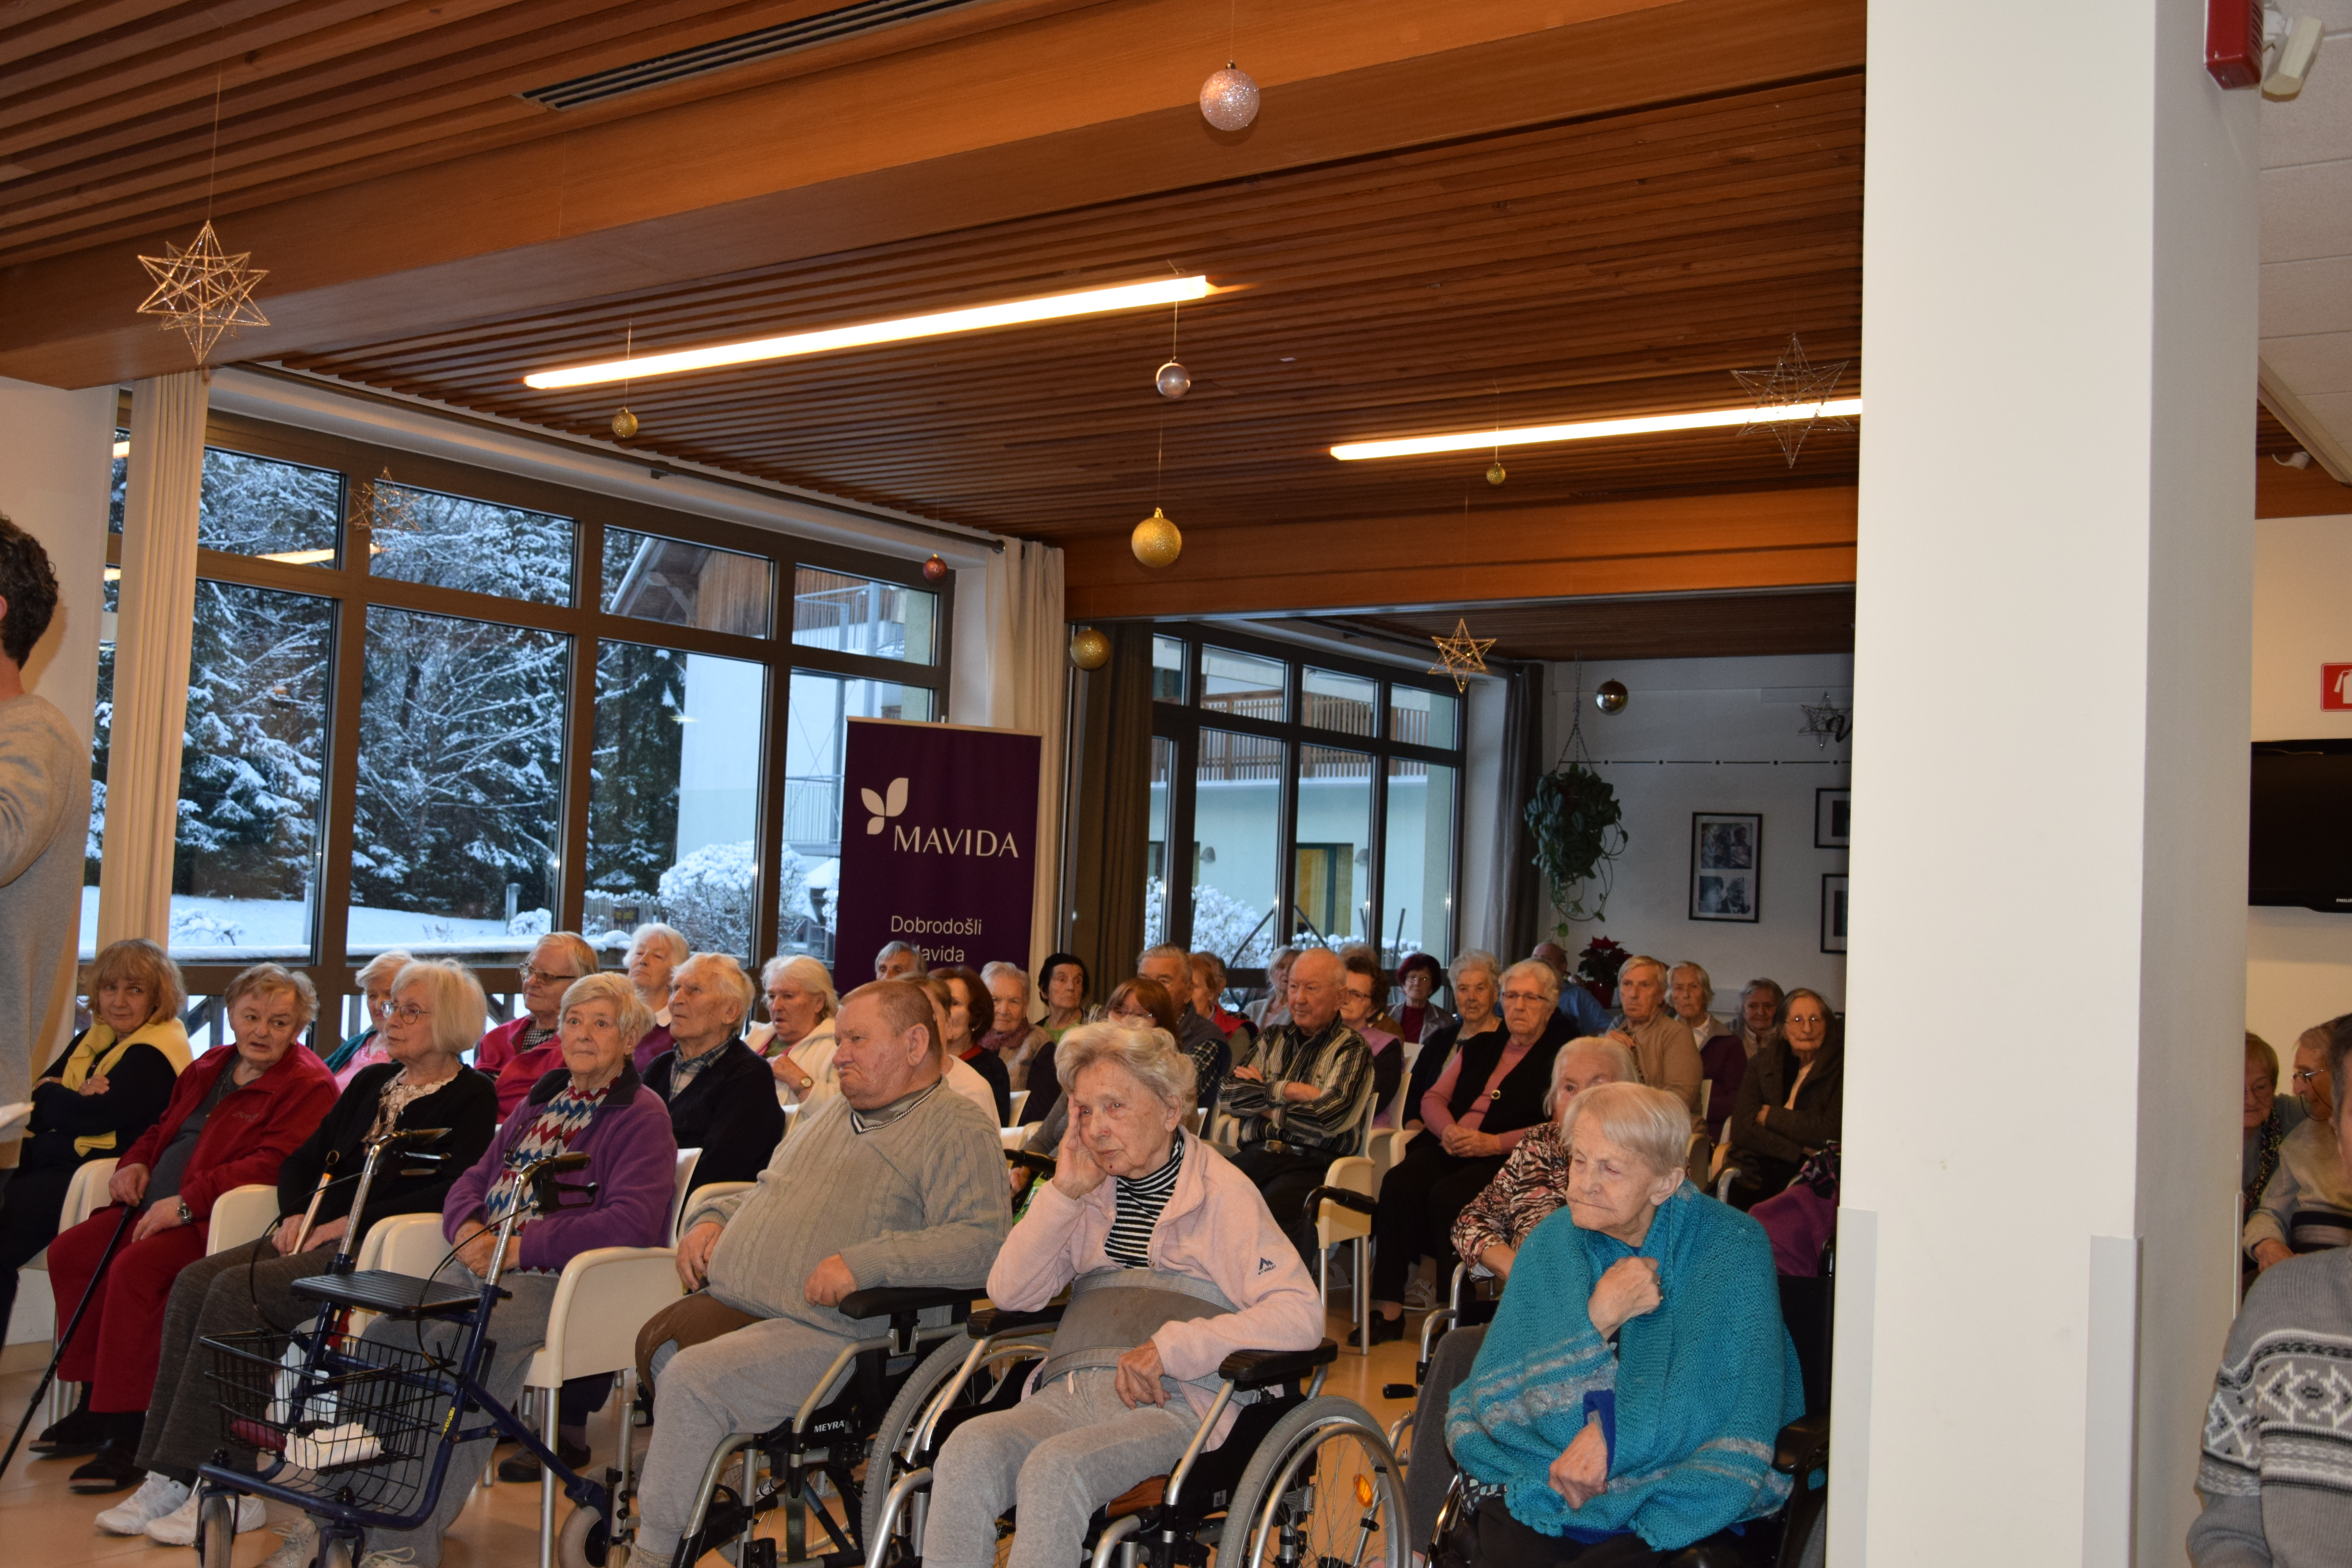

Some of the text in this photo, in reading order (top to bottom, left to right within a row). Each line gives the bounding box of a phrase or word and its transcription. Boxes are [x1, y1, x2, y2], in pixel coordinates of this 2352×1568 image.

[894, 825, 1019, 858] MAVIDA
[891, 915, 982, 935] Dobrodošli
[916, 944, 965, 962] avida
[814, 1420, 845, 1433] MEYRA
